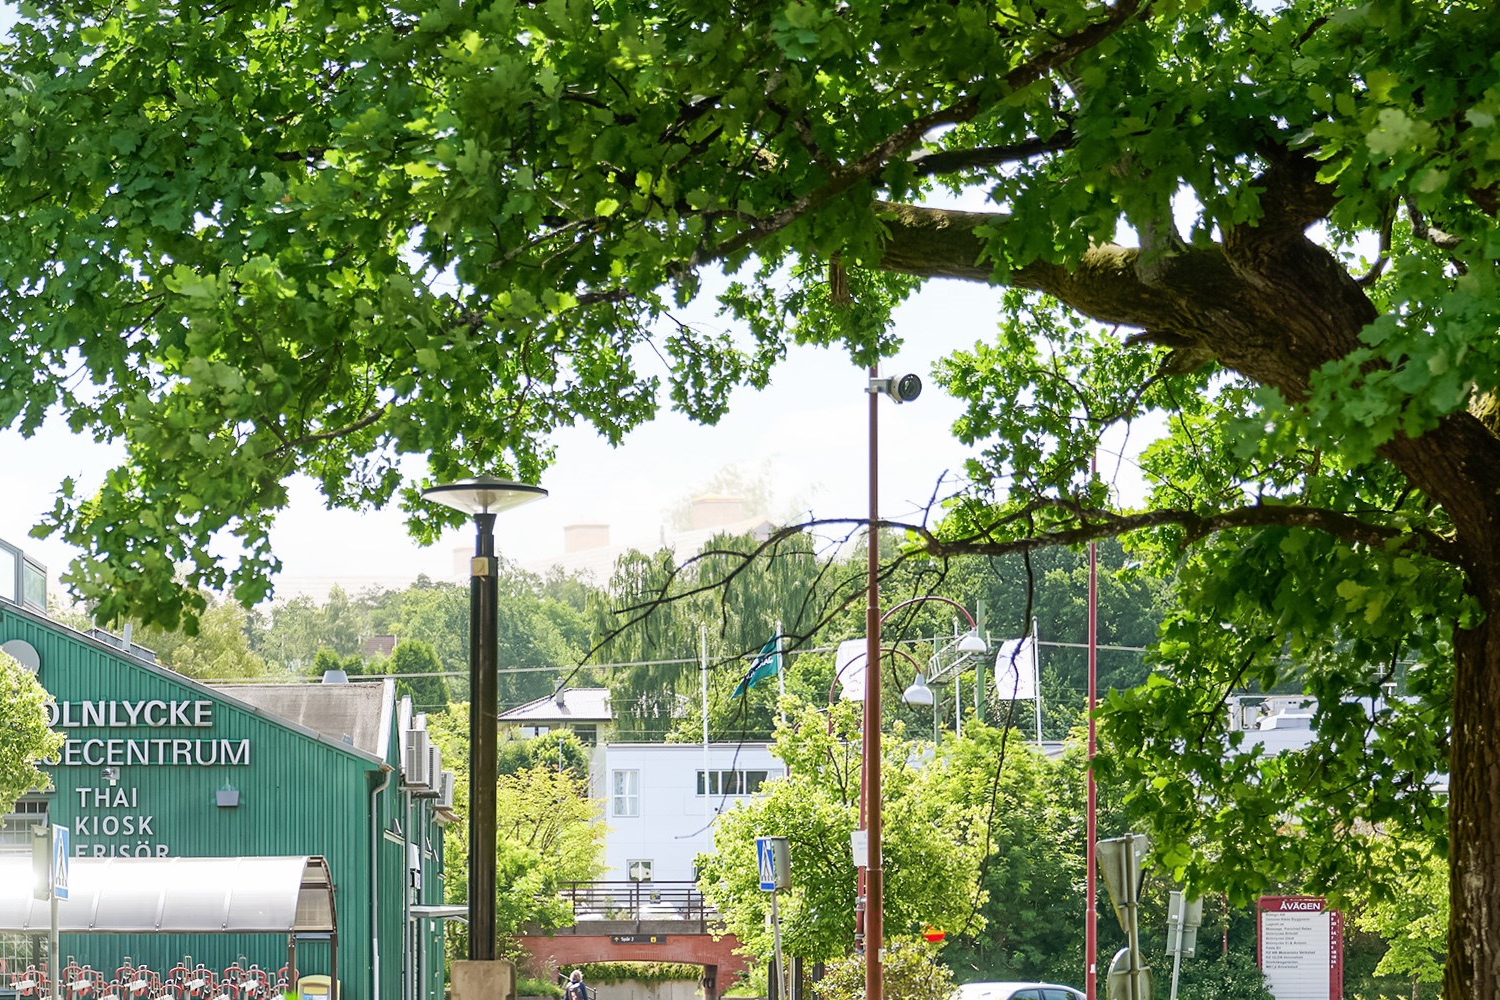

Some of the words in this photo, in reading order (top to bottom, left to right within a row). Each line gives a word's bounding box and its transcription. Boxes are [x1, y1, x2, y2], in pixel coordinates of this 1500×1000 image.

[75, 787, 137, 808] THAI
[75, 815, 154, 836] KIOSK
[1280, 901, 1320, 910] ÅVÄGEN
